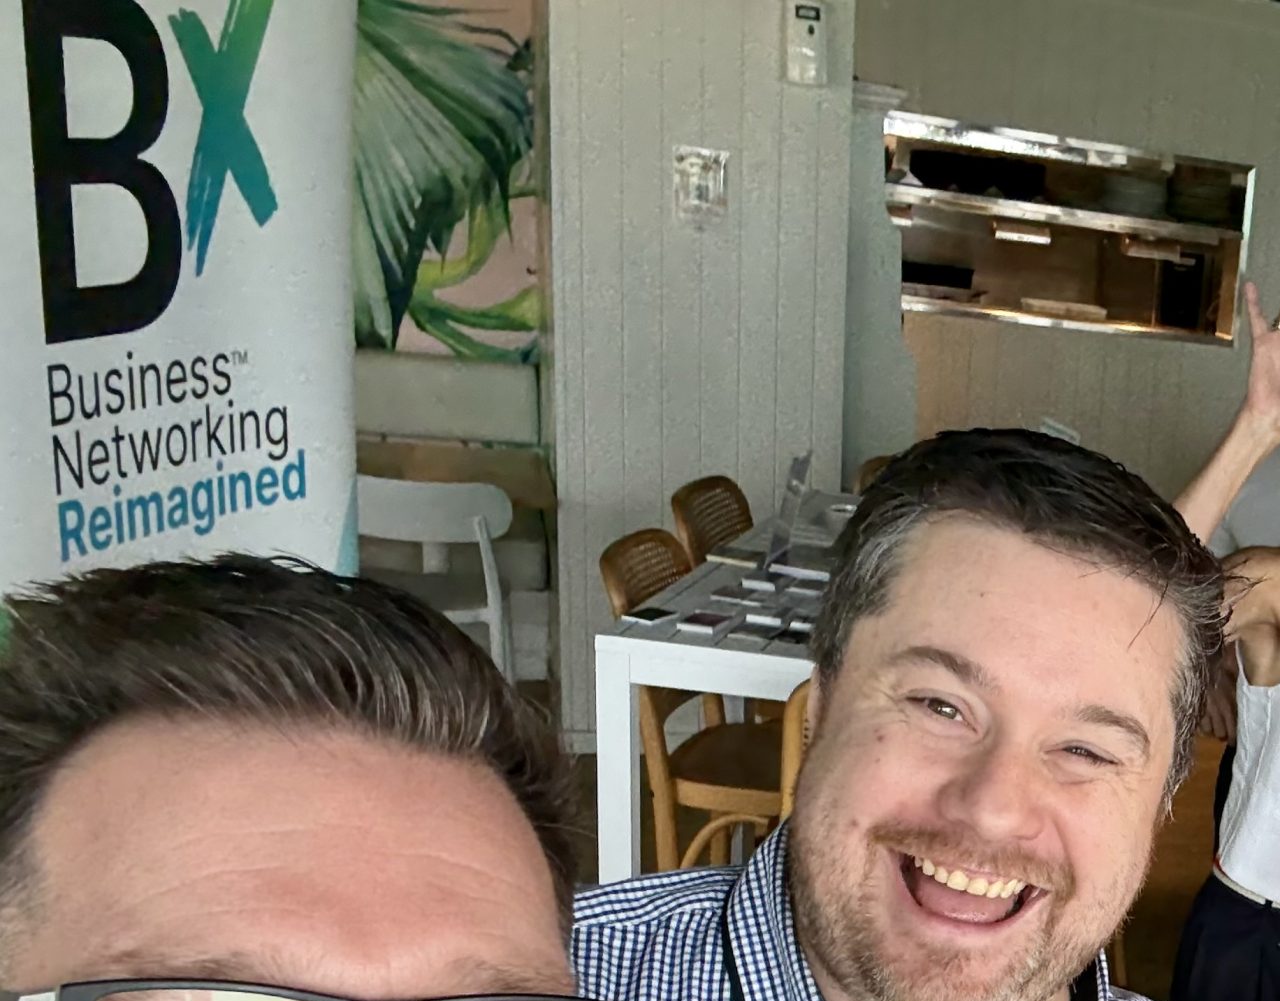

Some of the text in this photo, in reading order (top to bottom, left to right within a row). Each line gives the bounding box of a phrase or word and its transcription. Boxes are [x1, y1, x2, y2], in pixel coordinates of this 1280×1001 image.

[47, 351, 232, 427] Business
[52, 404, 289, 496] Networking
[58, 450, 307, 562] Reimagined
